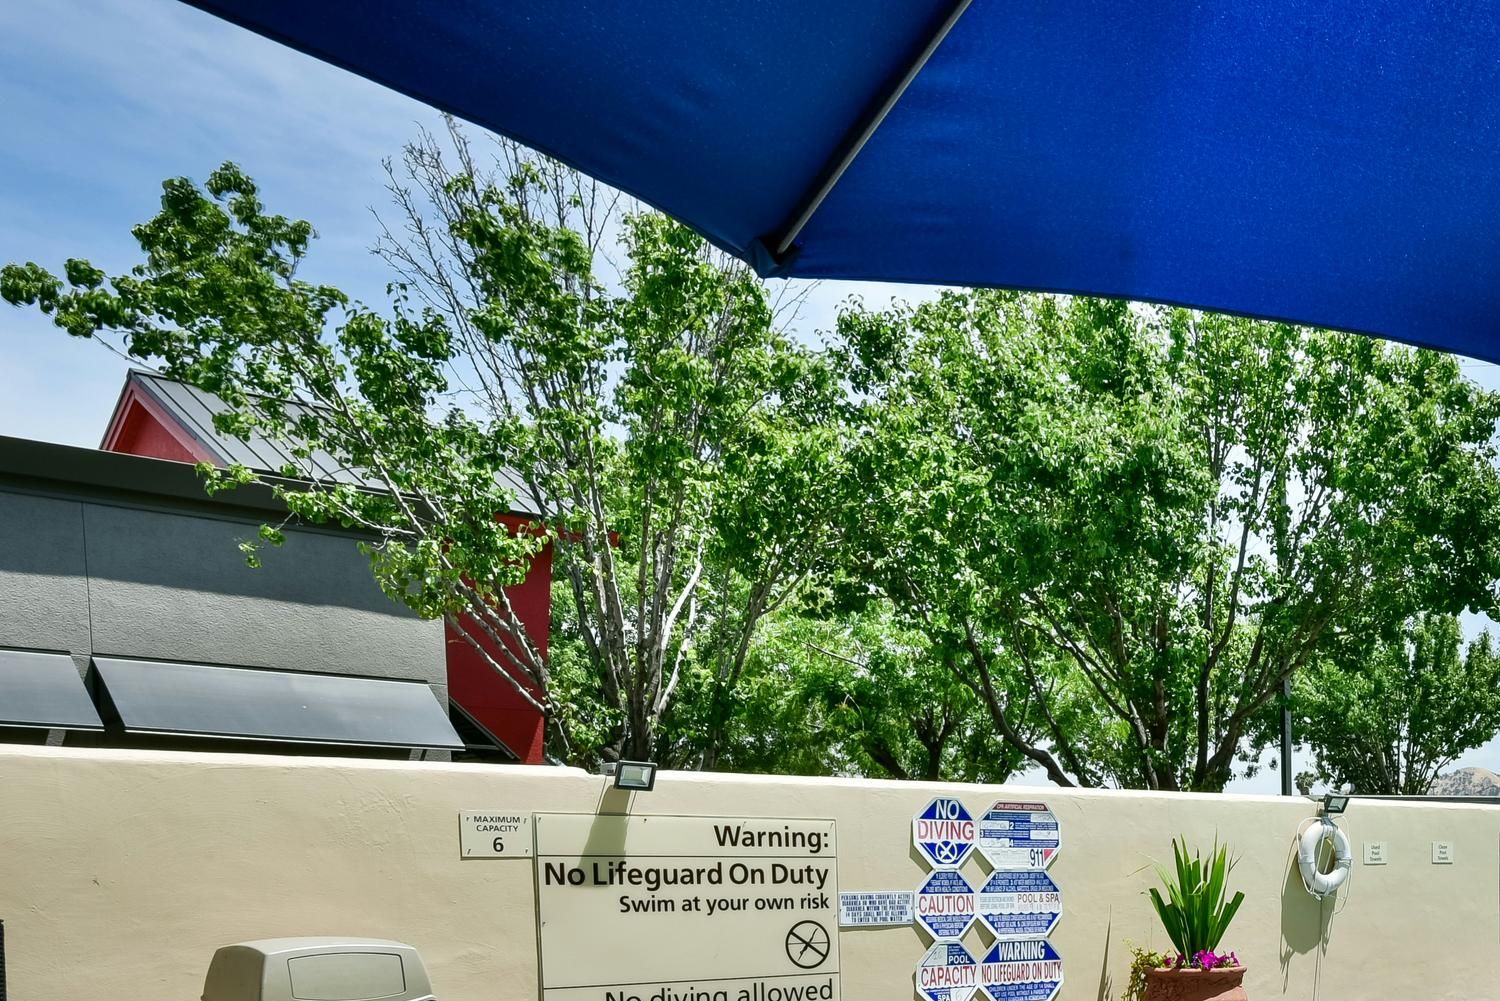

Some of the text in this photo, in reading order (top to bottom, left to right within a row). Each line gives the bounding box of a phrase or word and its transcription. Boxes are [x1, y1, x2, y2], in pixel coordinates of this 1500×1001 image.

[936, 800, 959, 819] NO
[714, 826, 829, 853] Warning:
[918, 820, 974, 840] DIVING
[493, 837, 504, 852] 6
[1030, 849, 1044, 866] 911
[545, 862, 829, 891] No Lifeguard On Duty
[620, 893, 829, 916] Swim at your own risk
[919, 895, 974, 913] CAUTION
[1018, 894, 1038, 903] POOL
[1039, 894, 1044, 903] &
[1046, 894, 1060, 904] SPA
[949, 955, 970, 964] POOL
[999, 942, 1045, 960] WARNING
[921, 966, 976, 986] CAPACITY
[982, 961, 1062, 983] NO LIFEGUARD ON DUTY
